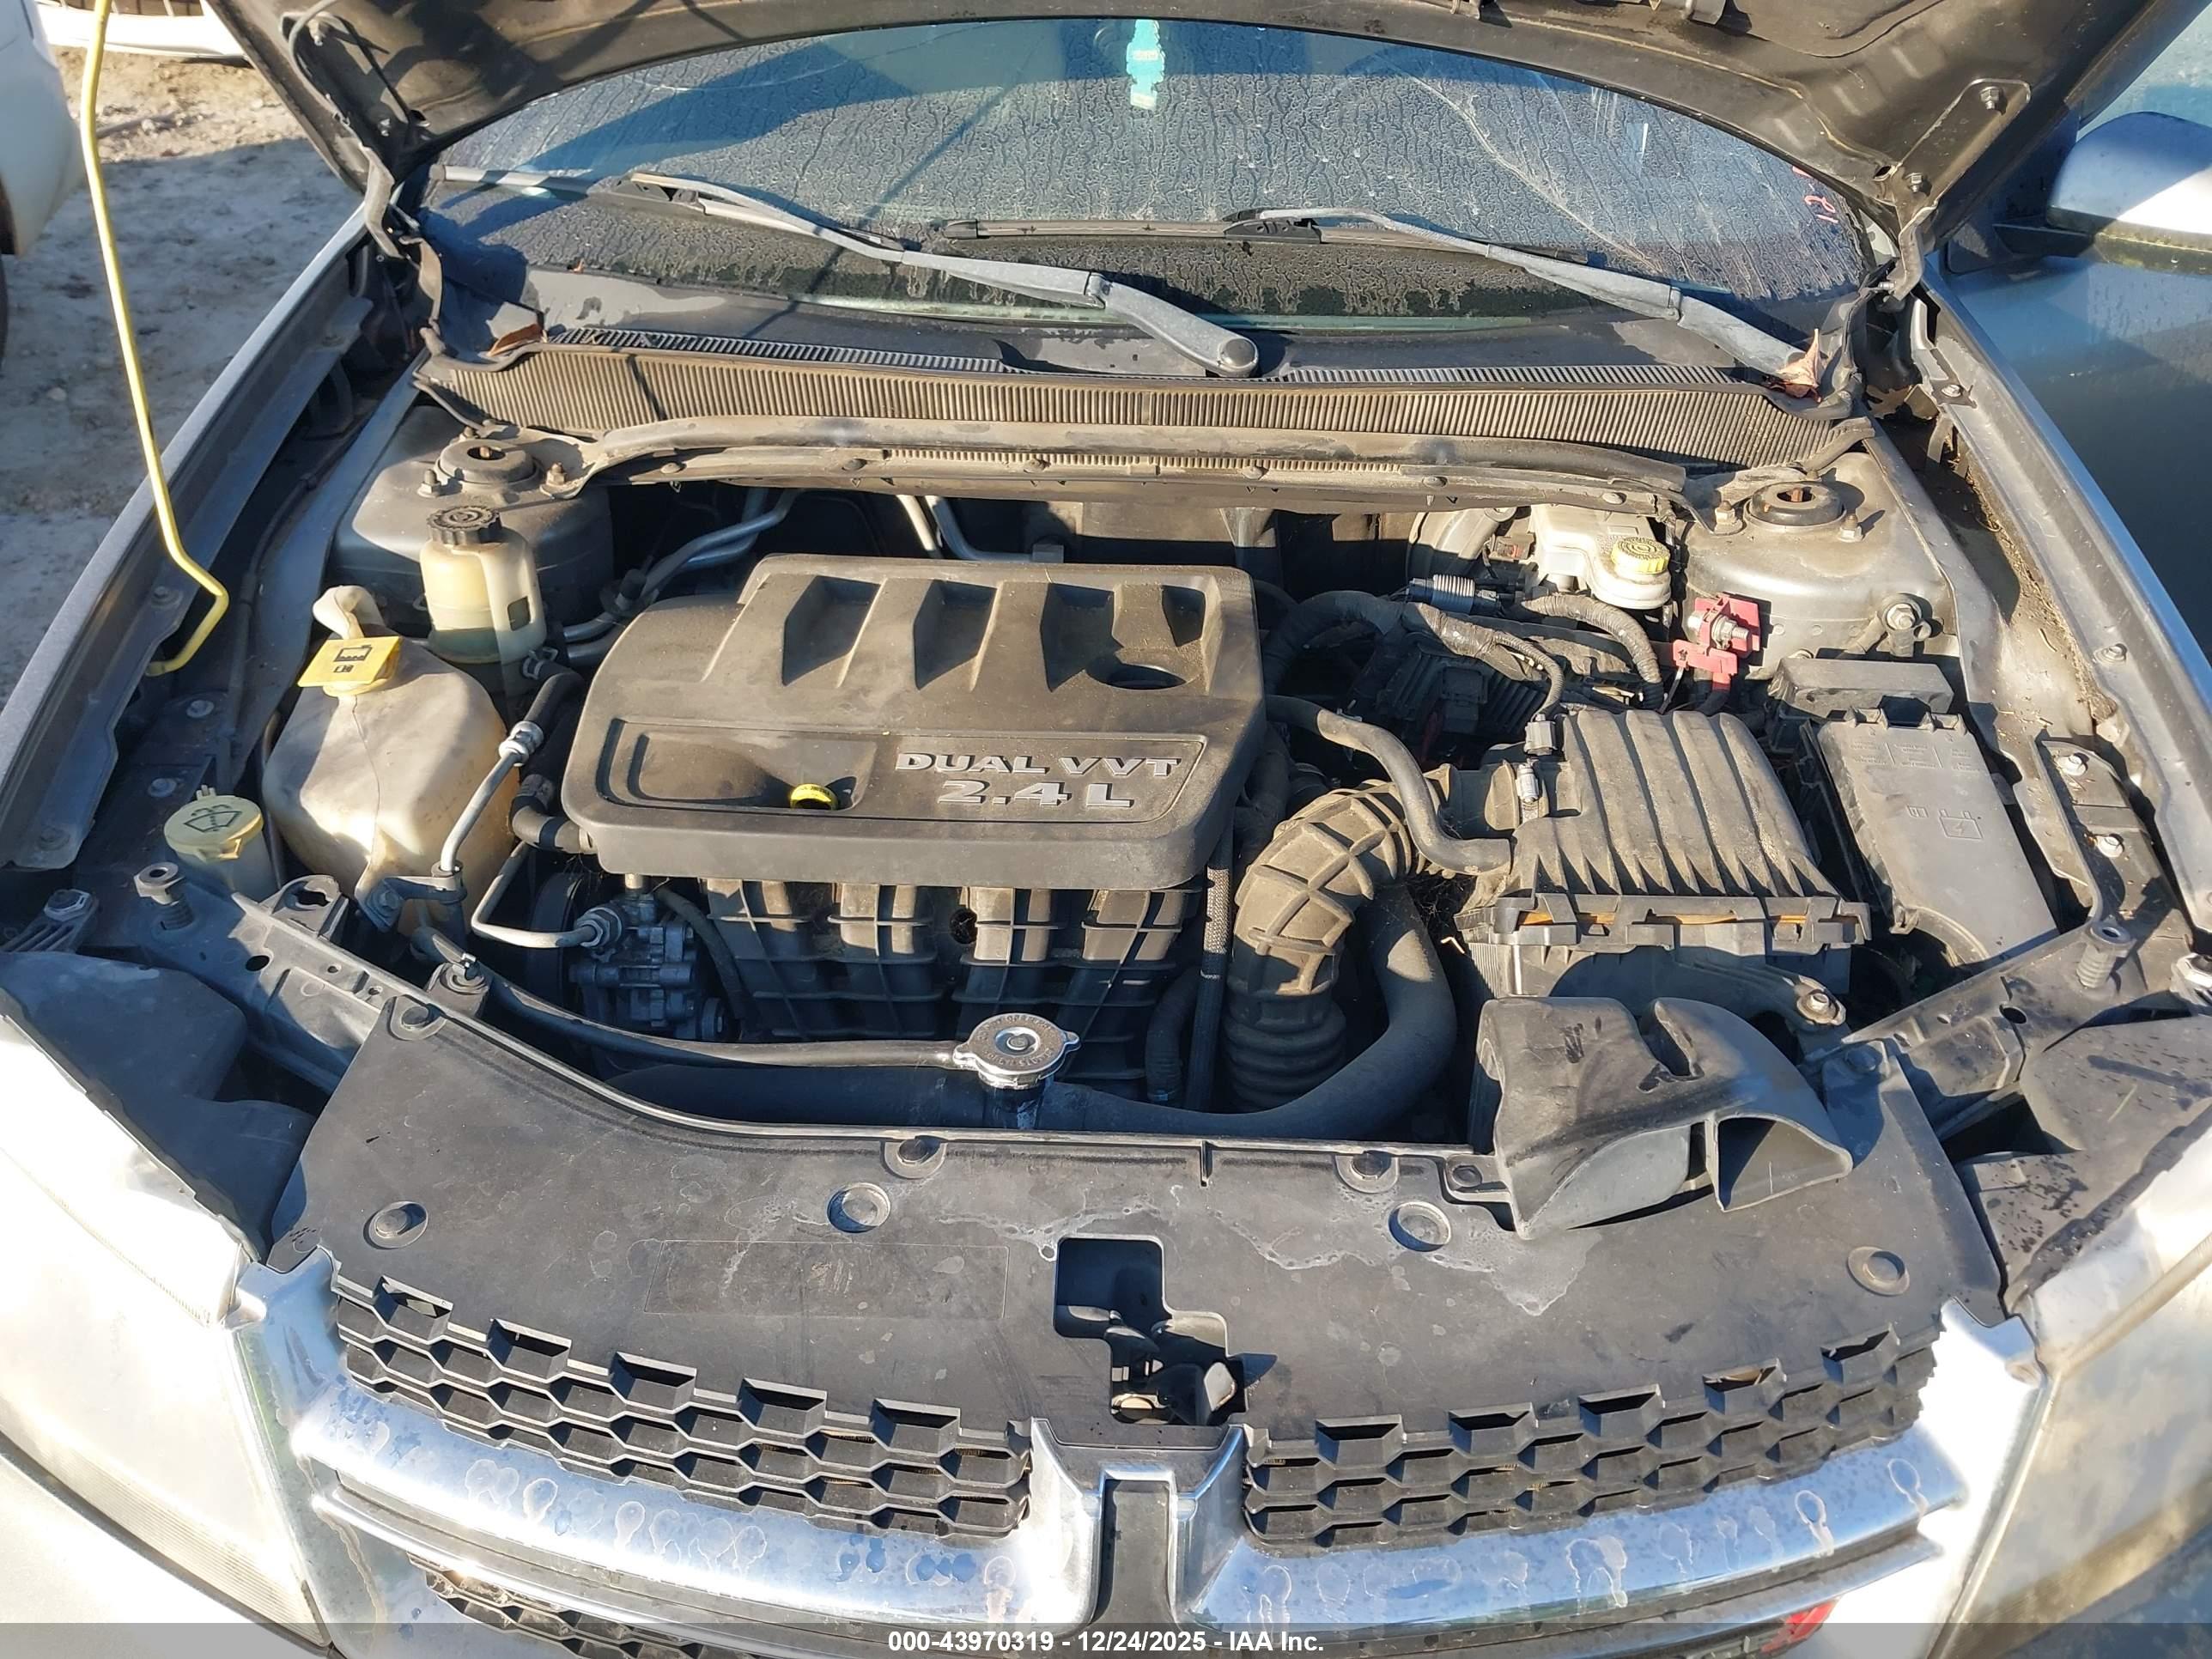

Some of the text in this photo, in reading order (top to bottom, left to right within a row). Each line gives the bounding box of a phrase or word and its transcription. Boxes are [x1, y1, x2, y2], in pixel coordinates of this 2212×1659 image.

[896, 752, 1182, 775] DUAL VVT
[938, 779, 1134, 807] 2.4 L
